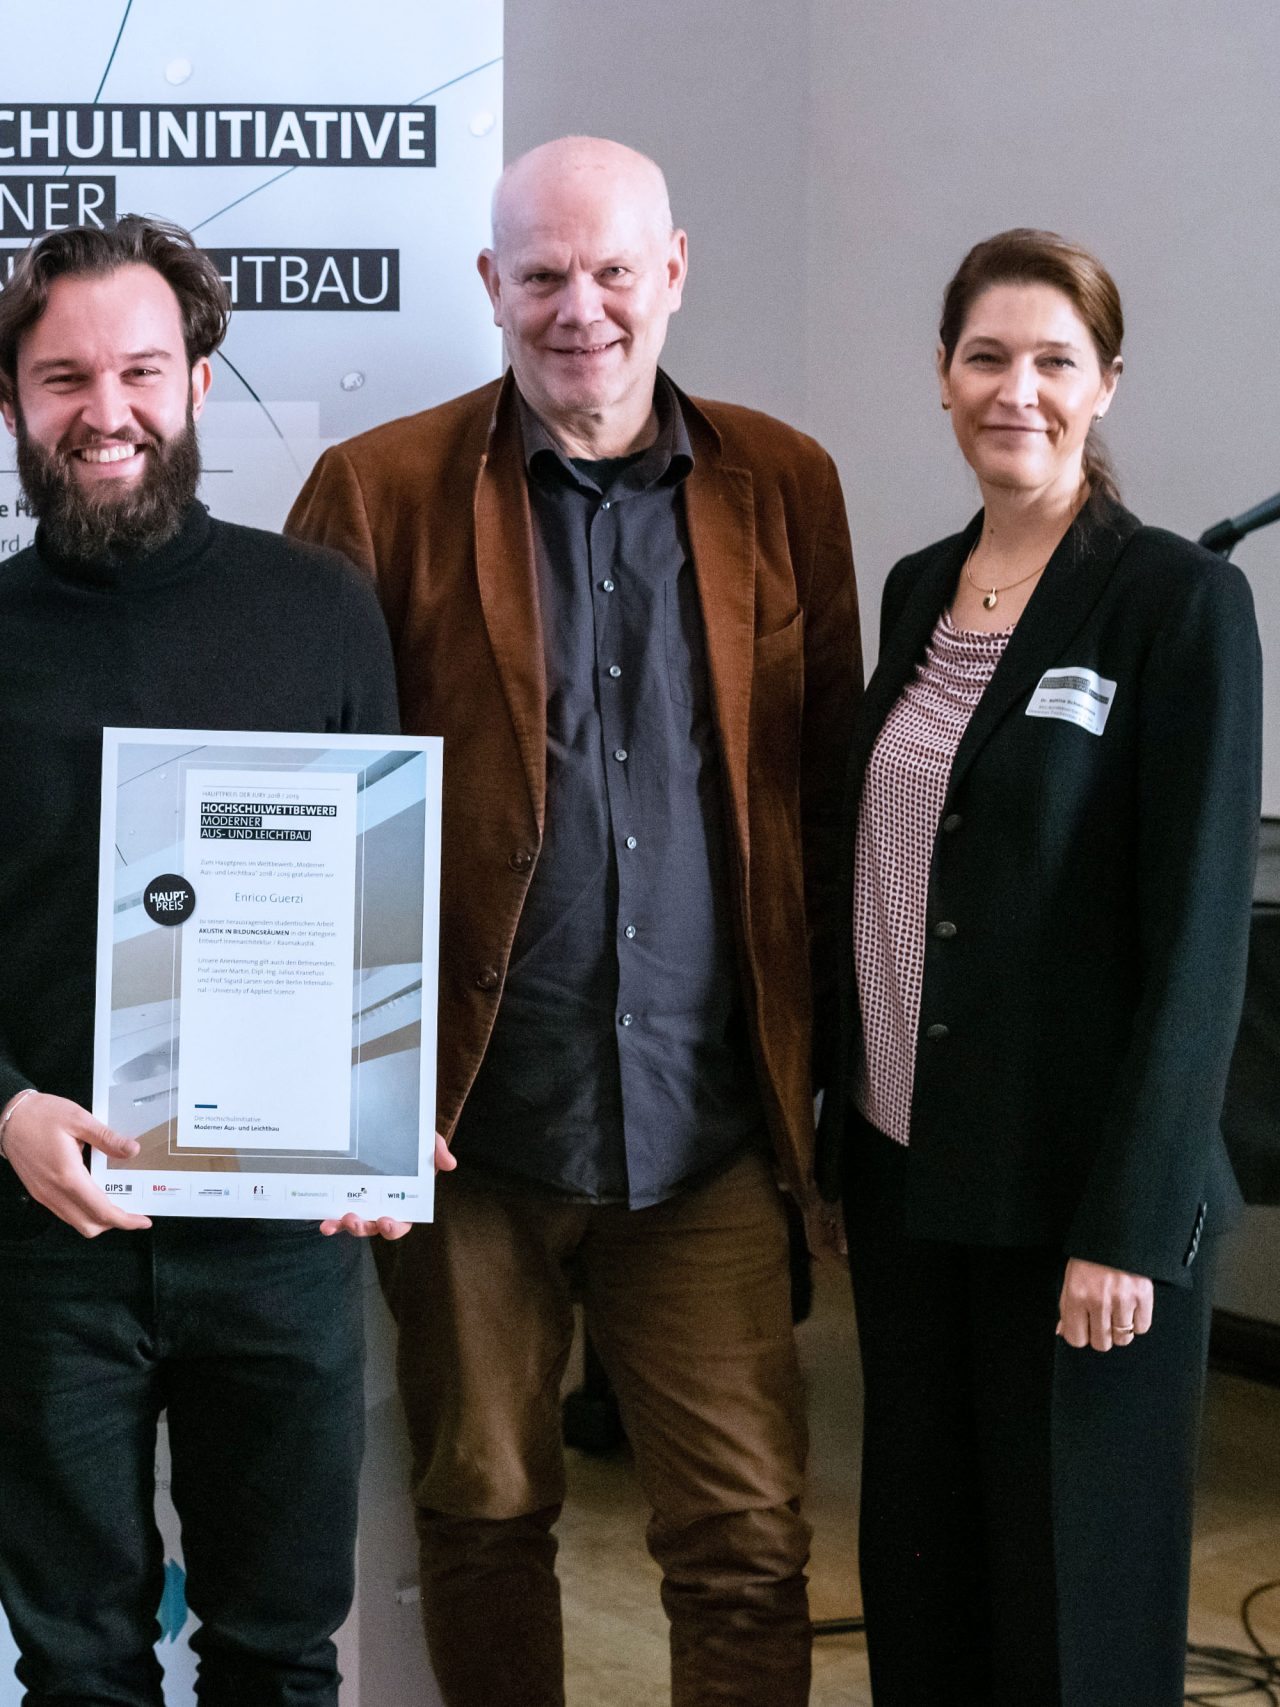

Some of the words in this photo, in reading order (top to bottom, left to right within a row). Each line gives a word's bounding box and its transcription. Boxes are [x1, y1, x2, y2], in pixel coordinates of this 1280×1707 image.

[201, 803, 336, 816] HOCHSCHULWETTBEWERB
[201, 816, 261, 827] MODERNER
[201, 829, 226, 838] AUS-
[228, 829, 253, 839] UND
[255, 830, 311, 841] LEICHTBAU
[150, 891, 189, 903] HAUPT-
[235, 892, 267, 903] Enrico
[269, 893, 304, 904] Guerzi
[156, 901, 184, 911] PREIS
[105, 1184, 123, 1192] GIPS
